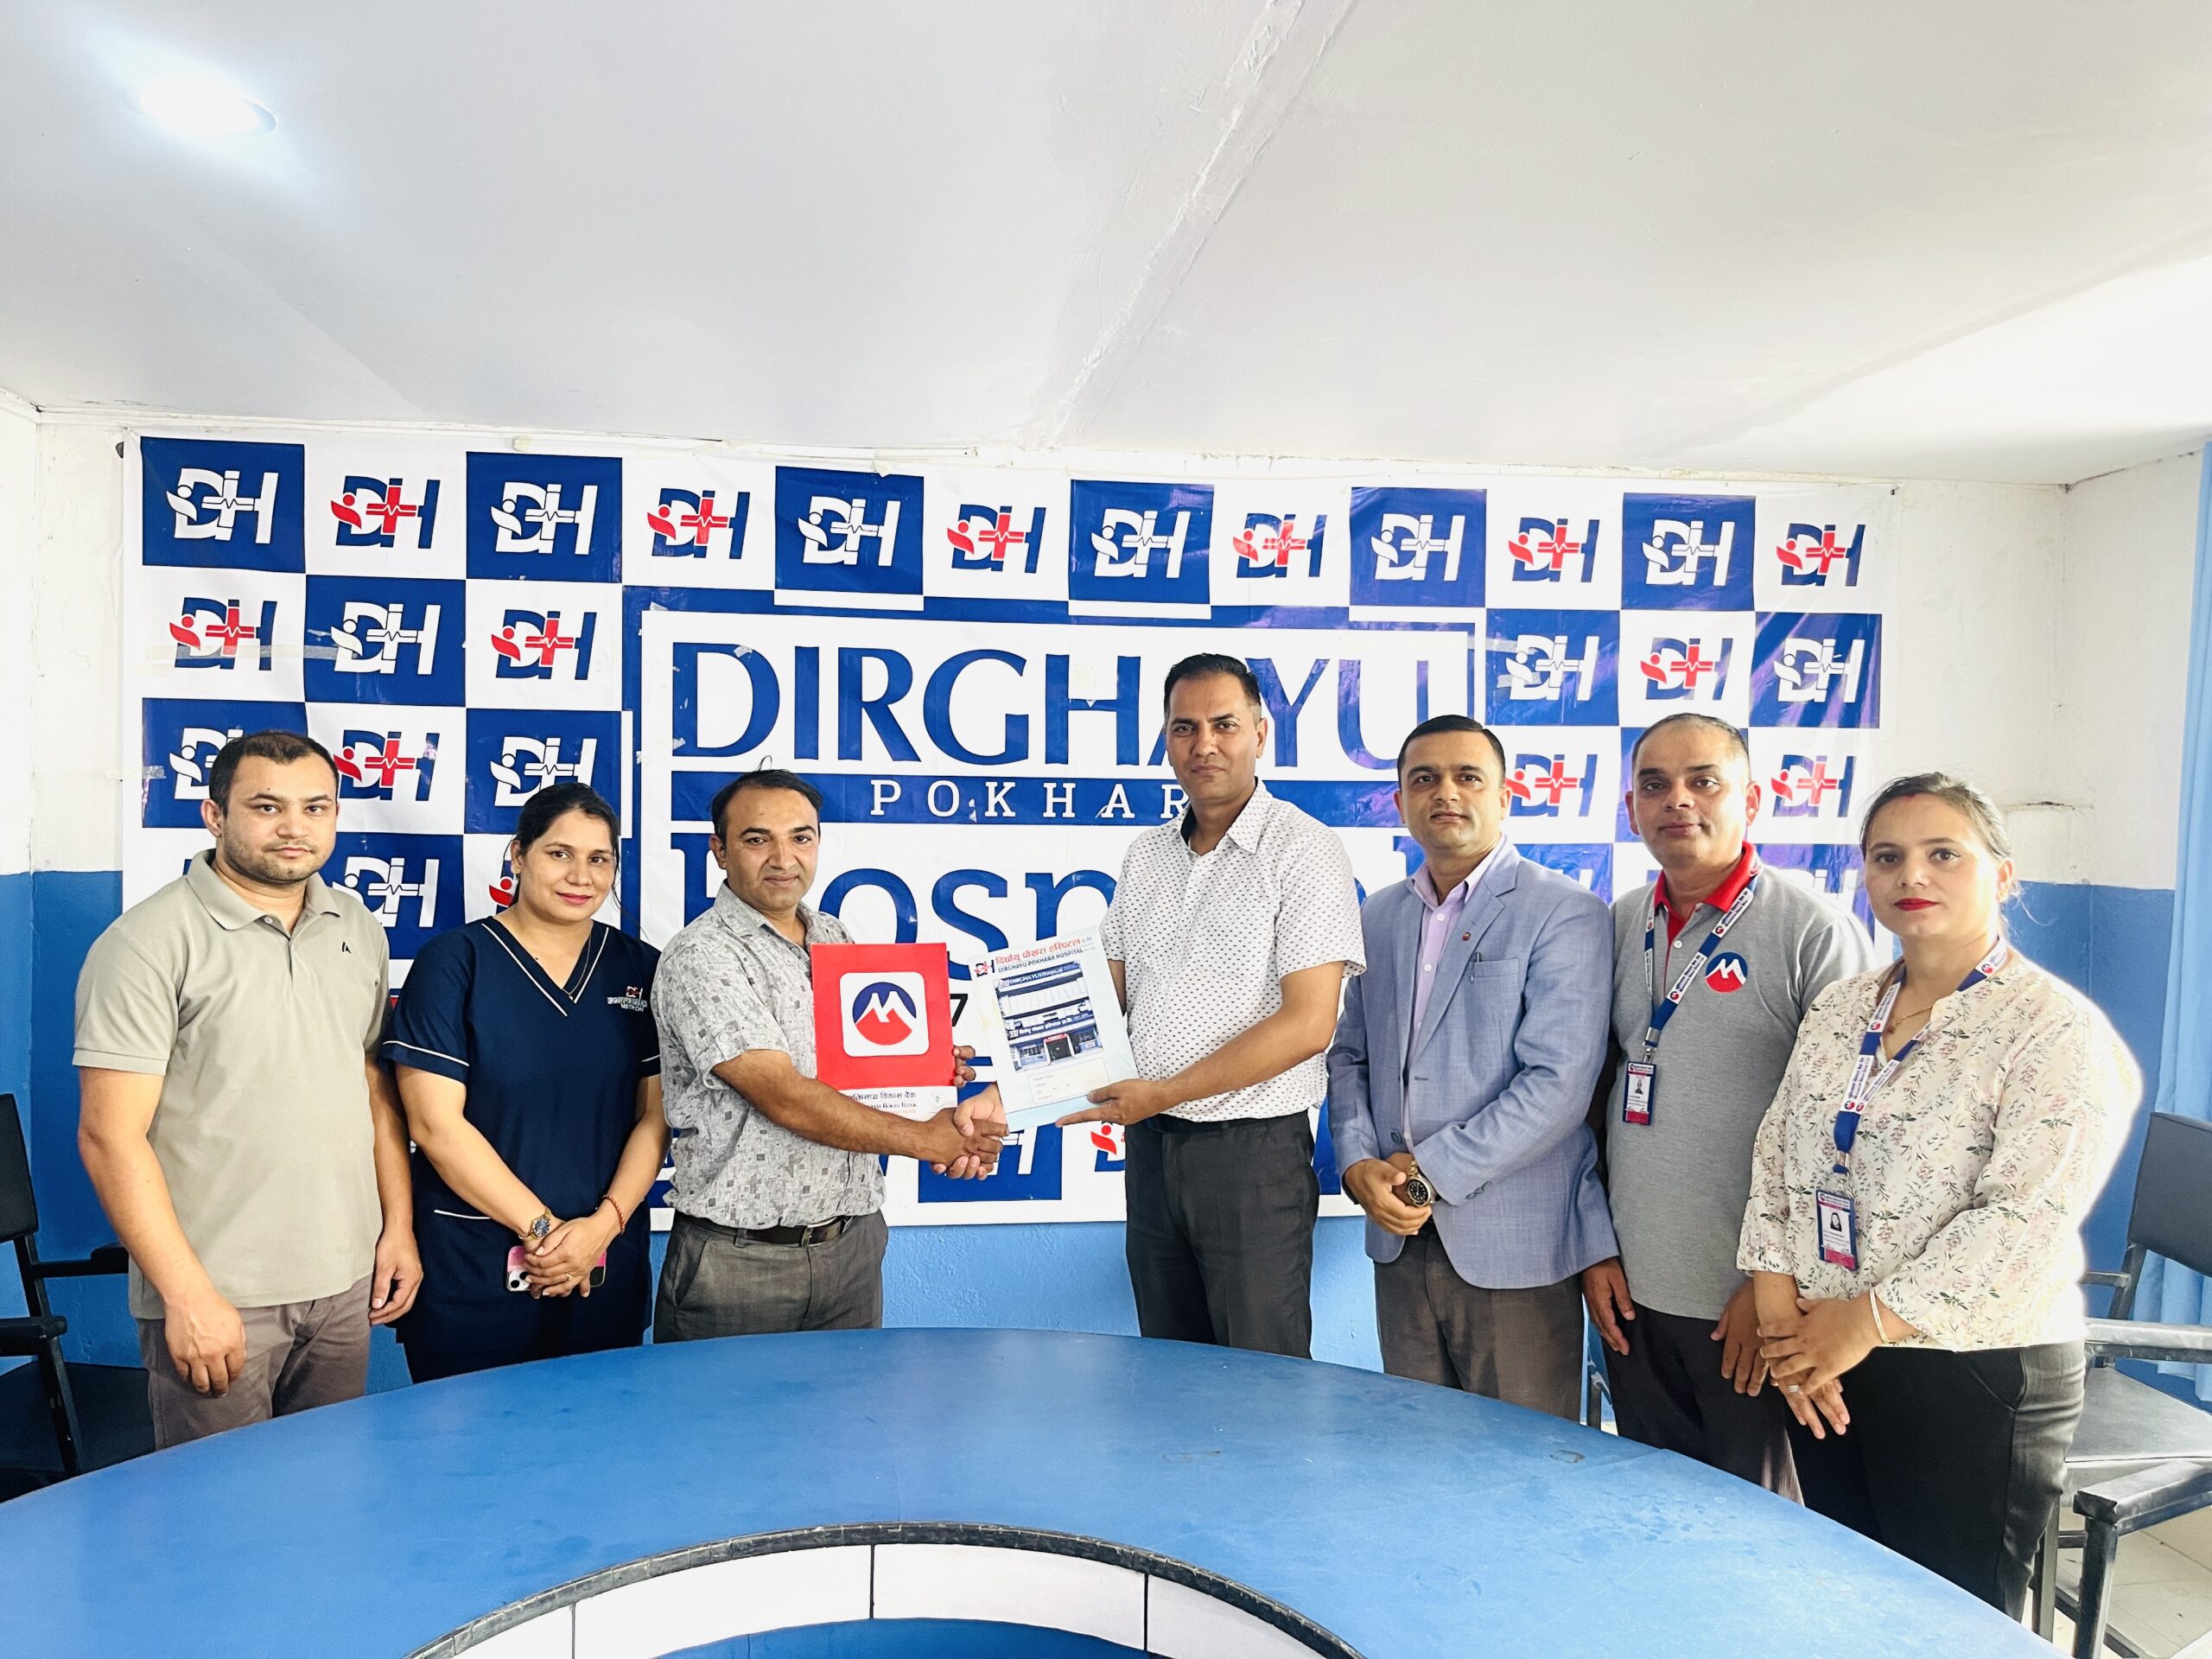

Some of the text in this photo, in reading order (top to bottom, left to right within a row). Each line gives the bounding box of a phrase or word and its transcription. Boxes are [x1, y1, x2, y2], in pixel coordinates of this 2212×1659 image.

[672, 642, 1428, 771] DIRGHYU
[871, 779, 1190, 820] POKHAR
[998, 960, 1027, 974] DIRGHAYU
[1027, 954, 1055, 967] POKHARA
[1056, 947, 1084, 961] HOSPITAL
